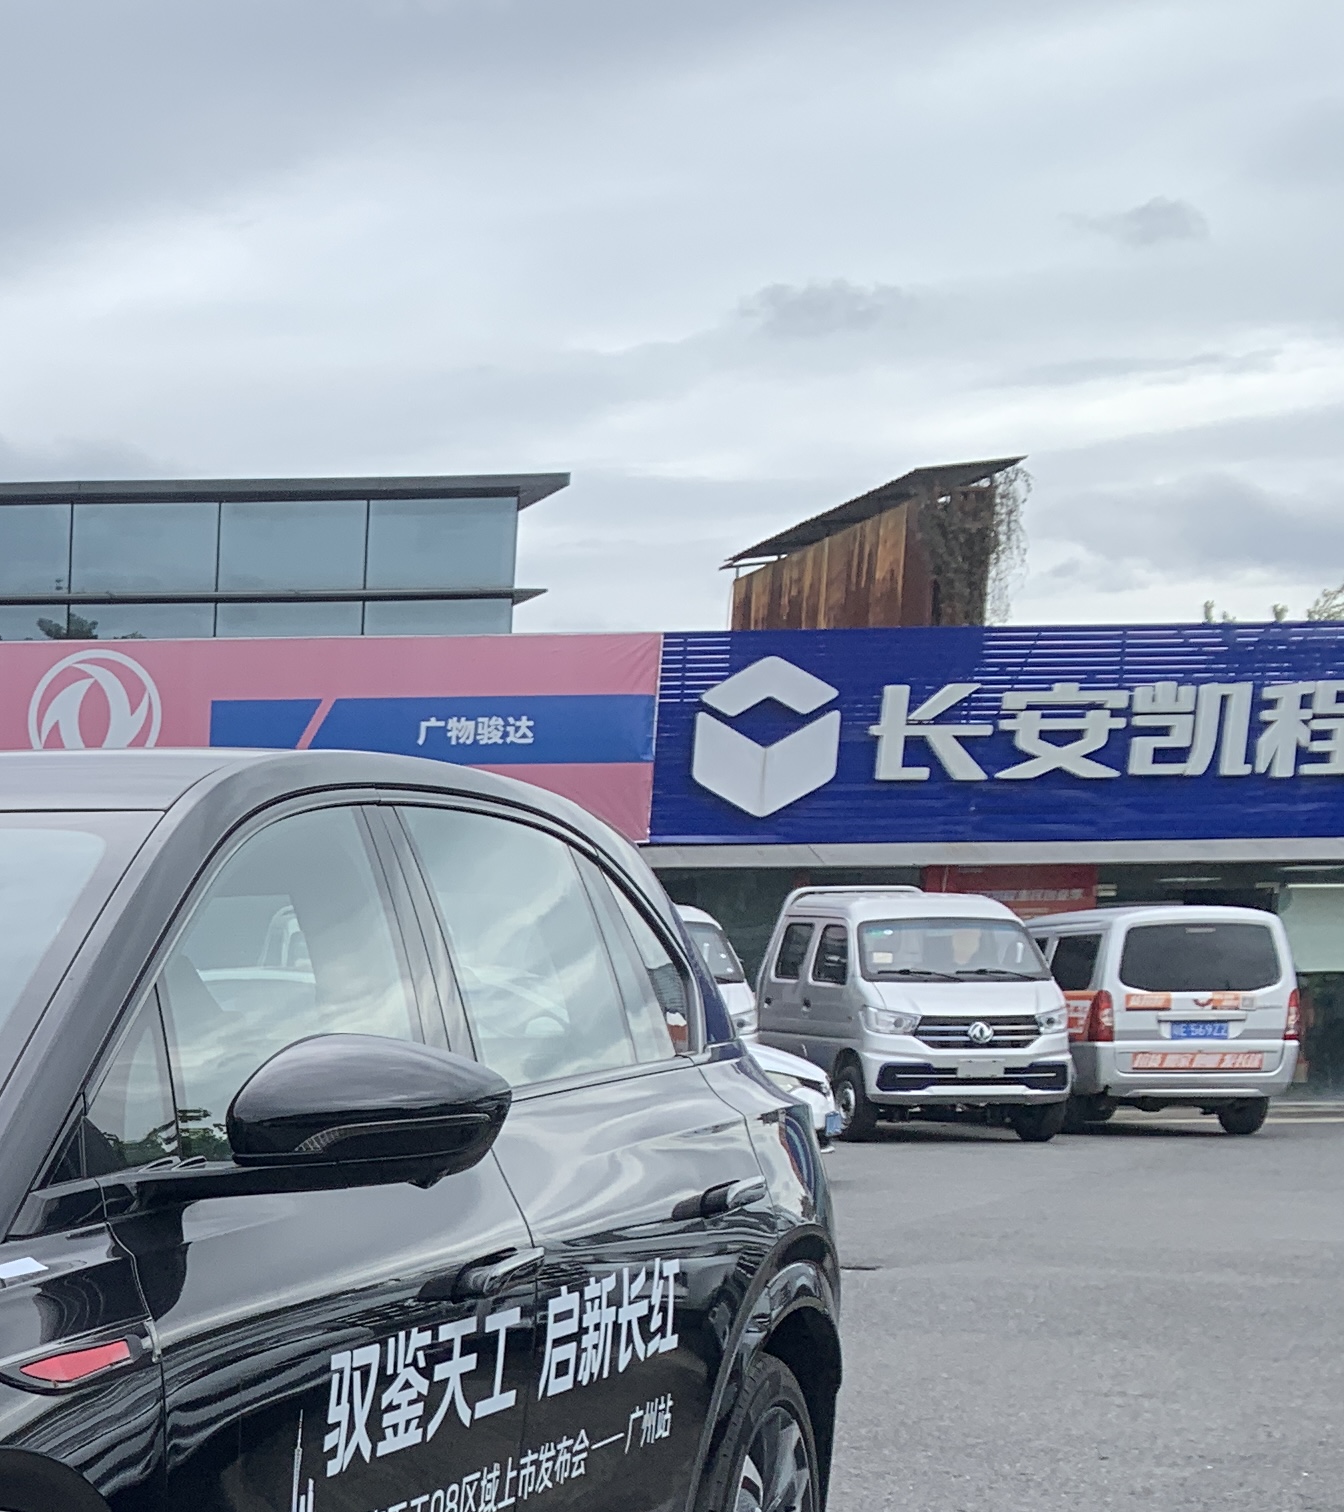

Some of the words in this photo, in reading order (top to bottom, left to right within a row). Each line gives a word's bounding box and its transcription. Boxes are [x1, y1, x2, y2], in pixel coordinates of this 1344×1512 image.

[416, 715, 535, 746] 广物骏达
[868, 681, 1344, 781] 长安凯程
[322, 1305, 522, 1478] 驭鉴天工
[537, 1257, 681, 1402] 启新长红
